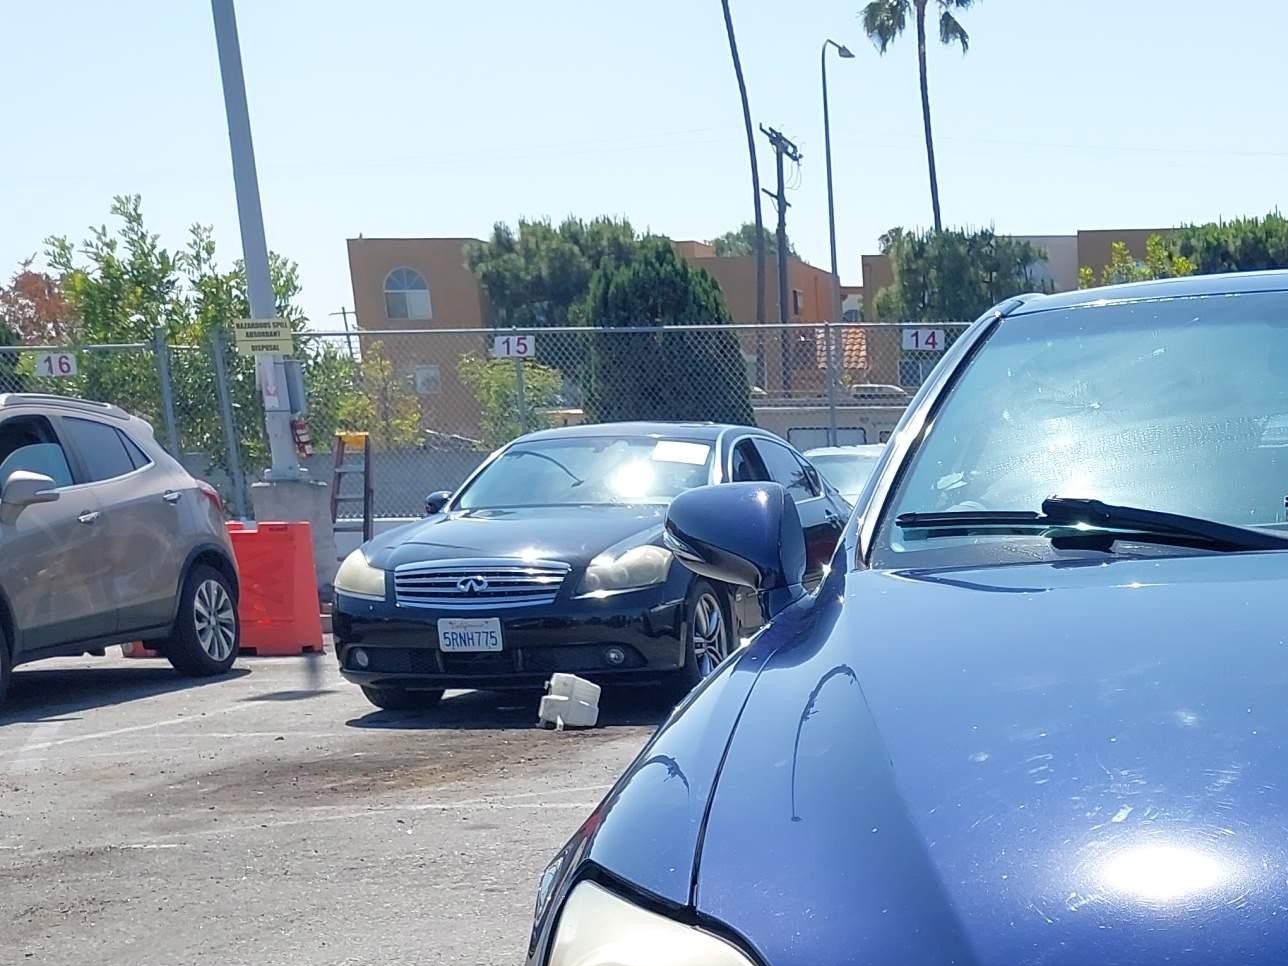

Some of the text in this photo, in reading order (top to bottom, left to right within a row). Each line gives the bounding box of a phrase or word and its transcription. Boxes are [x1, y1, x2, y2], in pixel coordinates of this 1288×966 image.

[502, 336, 528, 355] 15
[910, 330, 938, 349] 14
[44, 355, 71, 374] 16
[443, 631, 498, 647] 5RNH775
